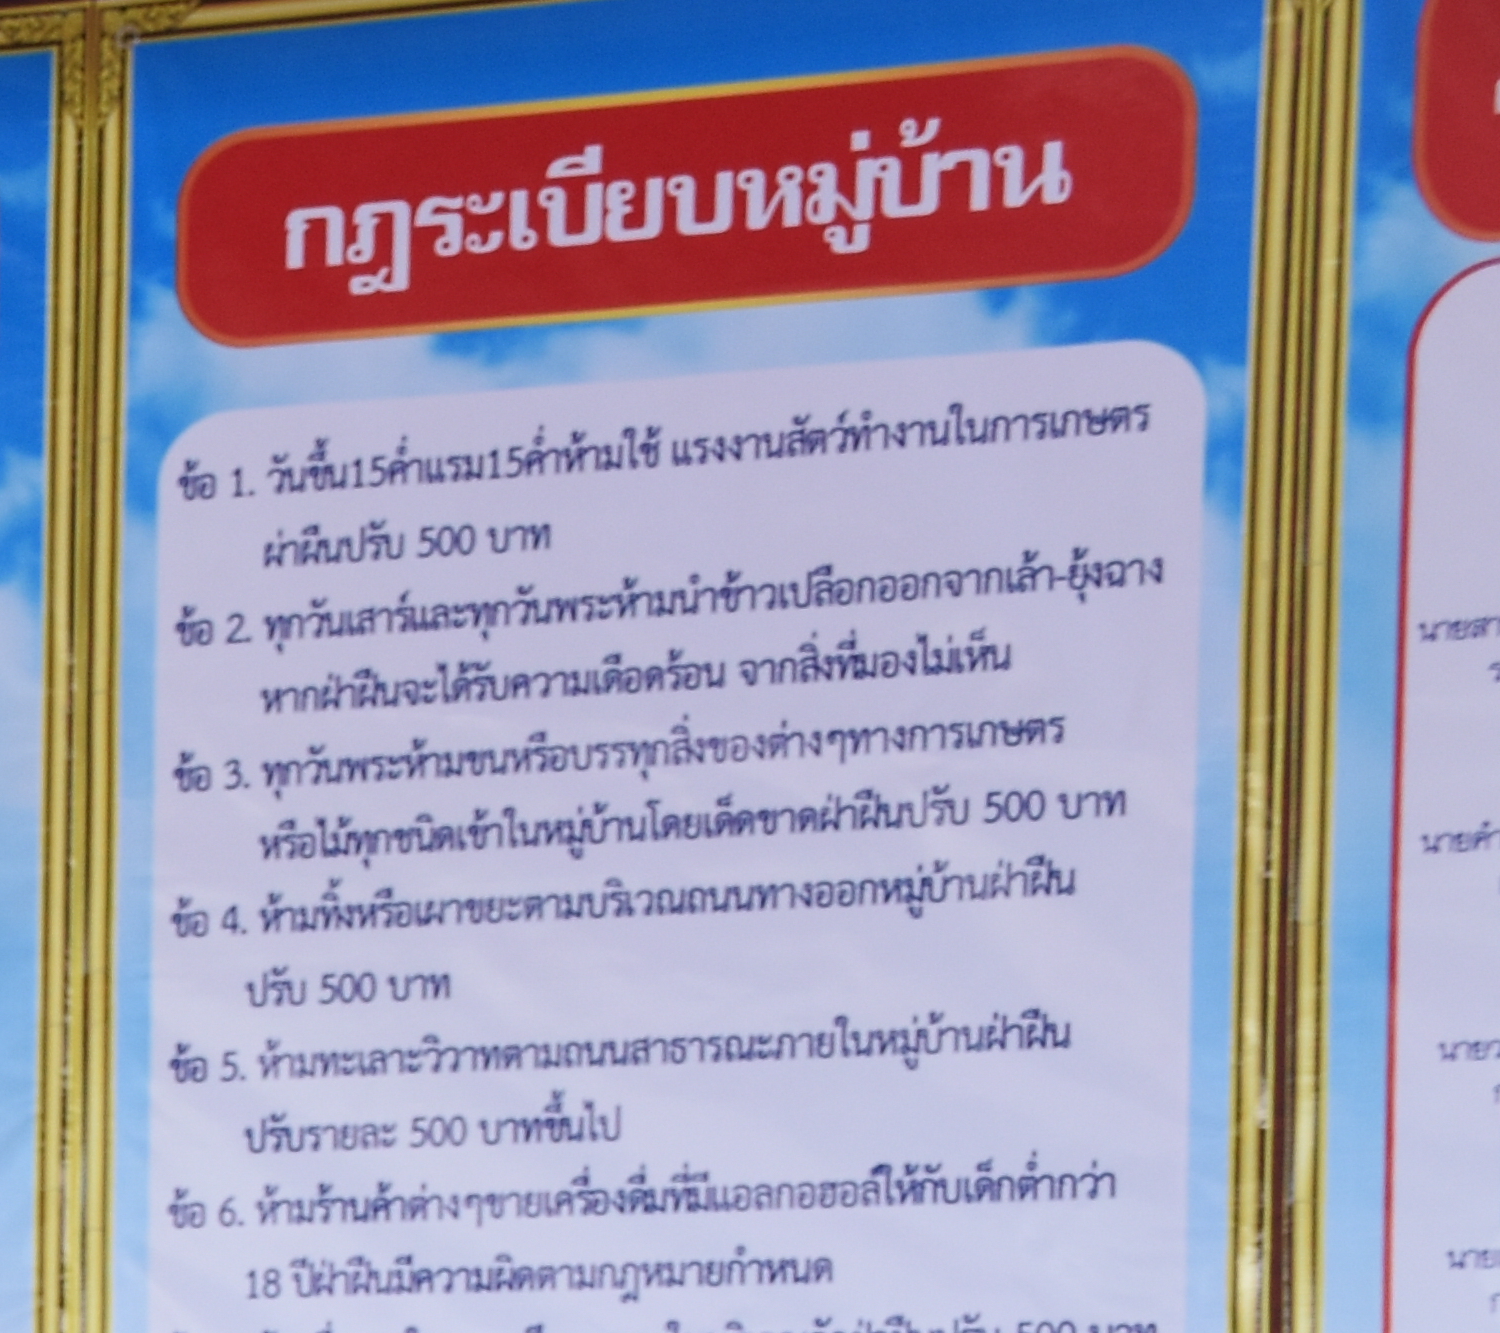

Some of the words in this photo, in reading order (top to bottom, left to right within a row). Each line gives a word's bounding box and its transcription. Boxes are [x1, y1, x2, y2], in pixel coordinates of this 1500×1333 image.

[177, 459, 216, 501] ข้อ
[232, 467, 255, 498] 1.
[417, 524, 476, 558] 500
[487, 523, 551, 554] บาท
[174, 605, 214, 647] ข้อ
[225, 612, 252, 644] 2.
[172, 751, 211, 793] ข้อ
[224, 758, 250, 790] 3.
[983, 789, 1046, 824] 500
[1057, 790, 1126, 820] บาท
[170, 896, 209, 938] ข้อ
[221, 905, 247, 935] 4.
[245, 966, 306, 1008] ปรับ
[319, 972, 377, 1005] 500
[387, 973, 451, 1002] บาท
[168, 1042, 208, 1083] ข้อ
[220, 1050, 246, 1082] 5.
[244, 1113, 396, 1154] ปรับรายละ
[410, 1115, 468, 1148] 500
[167, 1187, 206, 1229] ข้อ
[218, 1196, 244, 1228] 6.
[247, 1268, 281, 1299] 18
